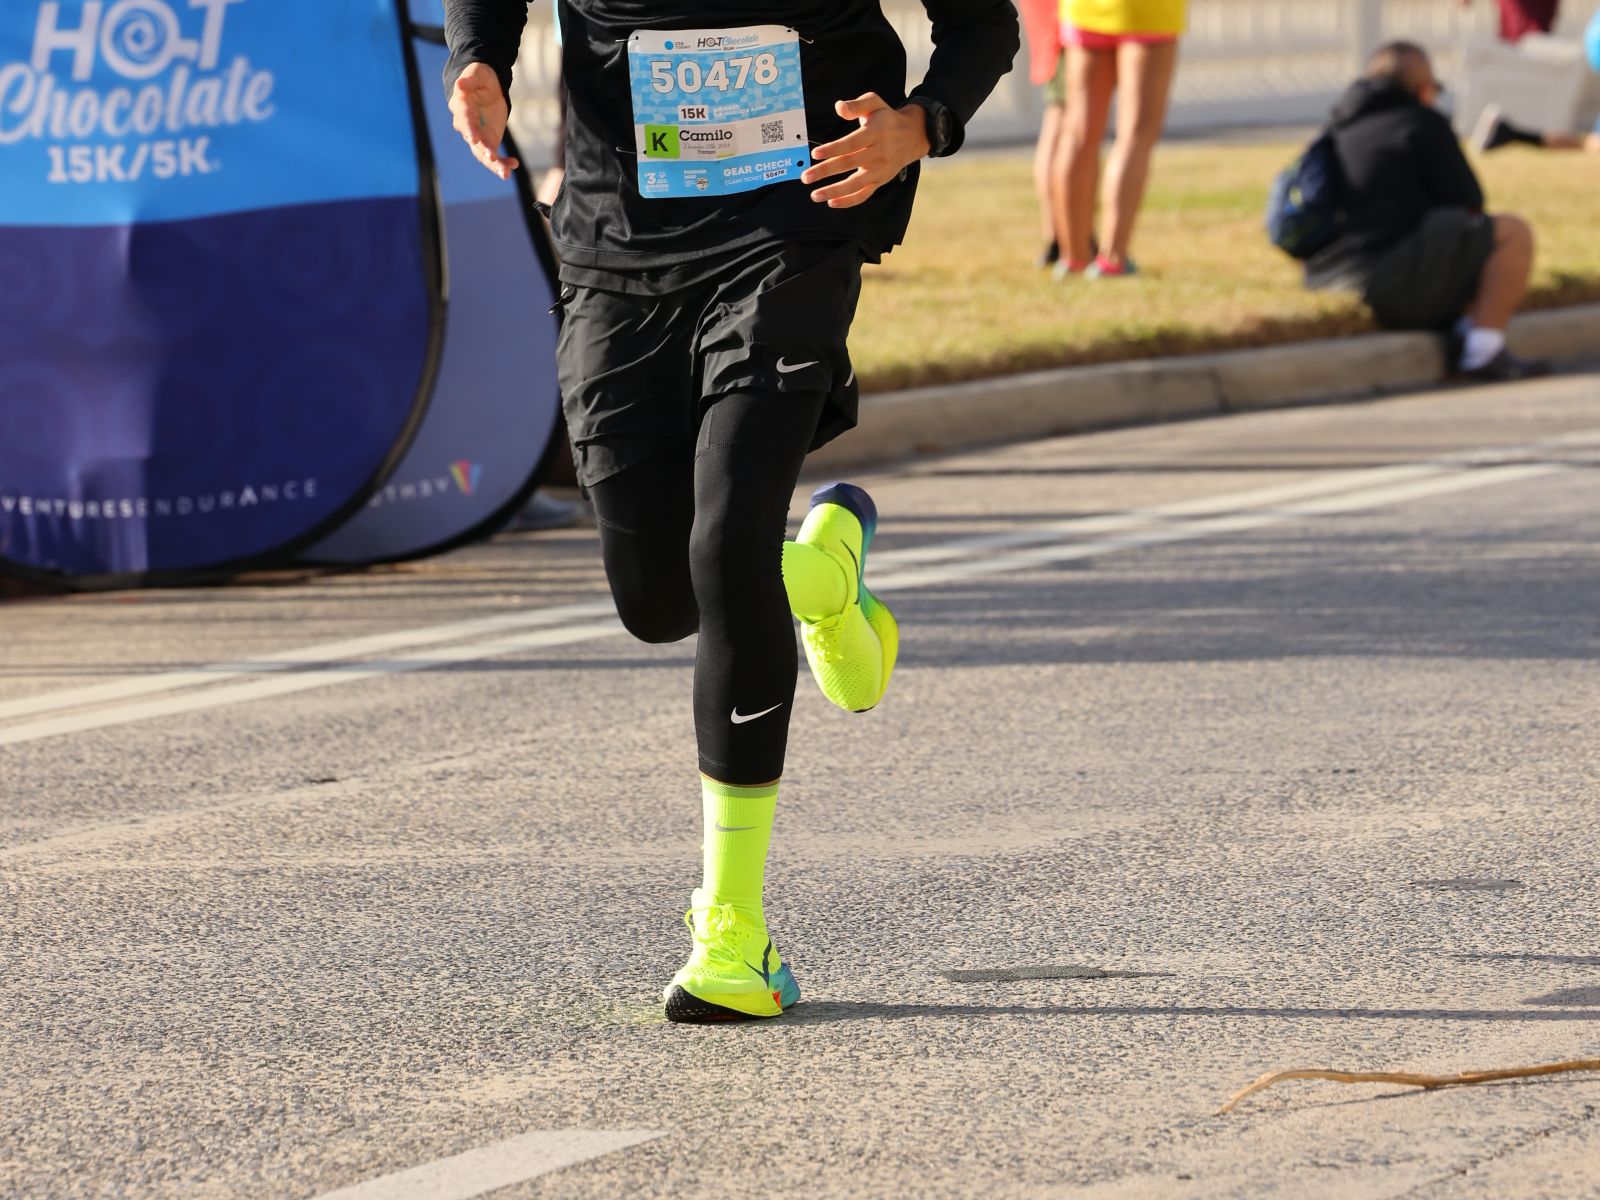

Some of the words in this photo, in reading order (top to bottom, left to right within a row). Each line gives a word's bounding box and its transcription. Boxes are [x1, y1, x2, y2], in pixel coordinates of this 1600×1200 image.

[697, 36, 723, 48] HOT
[721, 34, 760, 48] Chocolate
[651, 53, 779, 94] 50478
[0, 54, 274, 145] Chocolate
[680, 107, 706, 120] 15K
[651, 132, 668, 152] K
[679, 129, 733, 143] Camilo
[47, 137, 211, 183] 15K/5K
[723, 165, 753, 177] GEAR
[755, 158, 792, 172] CHECK
[724, 178, 743, 186] CLAIM
[744, 175, 762, 183] TICKET
[765, 169, 785, 179] 50478
